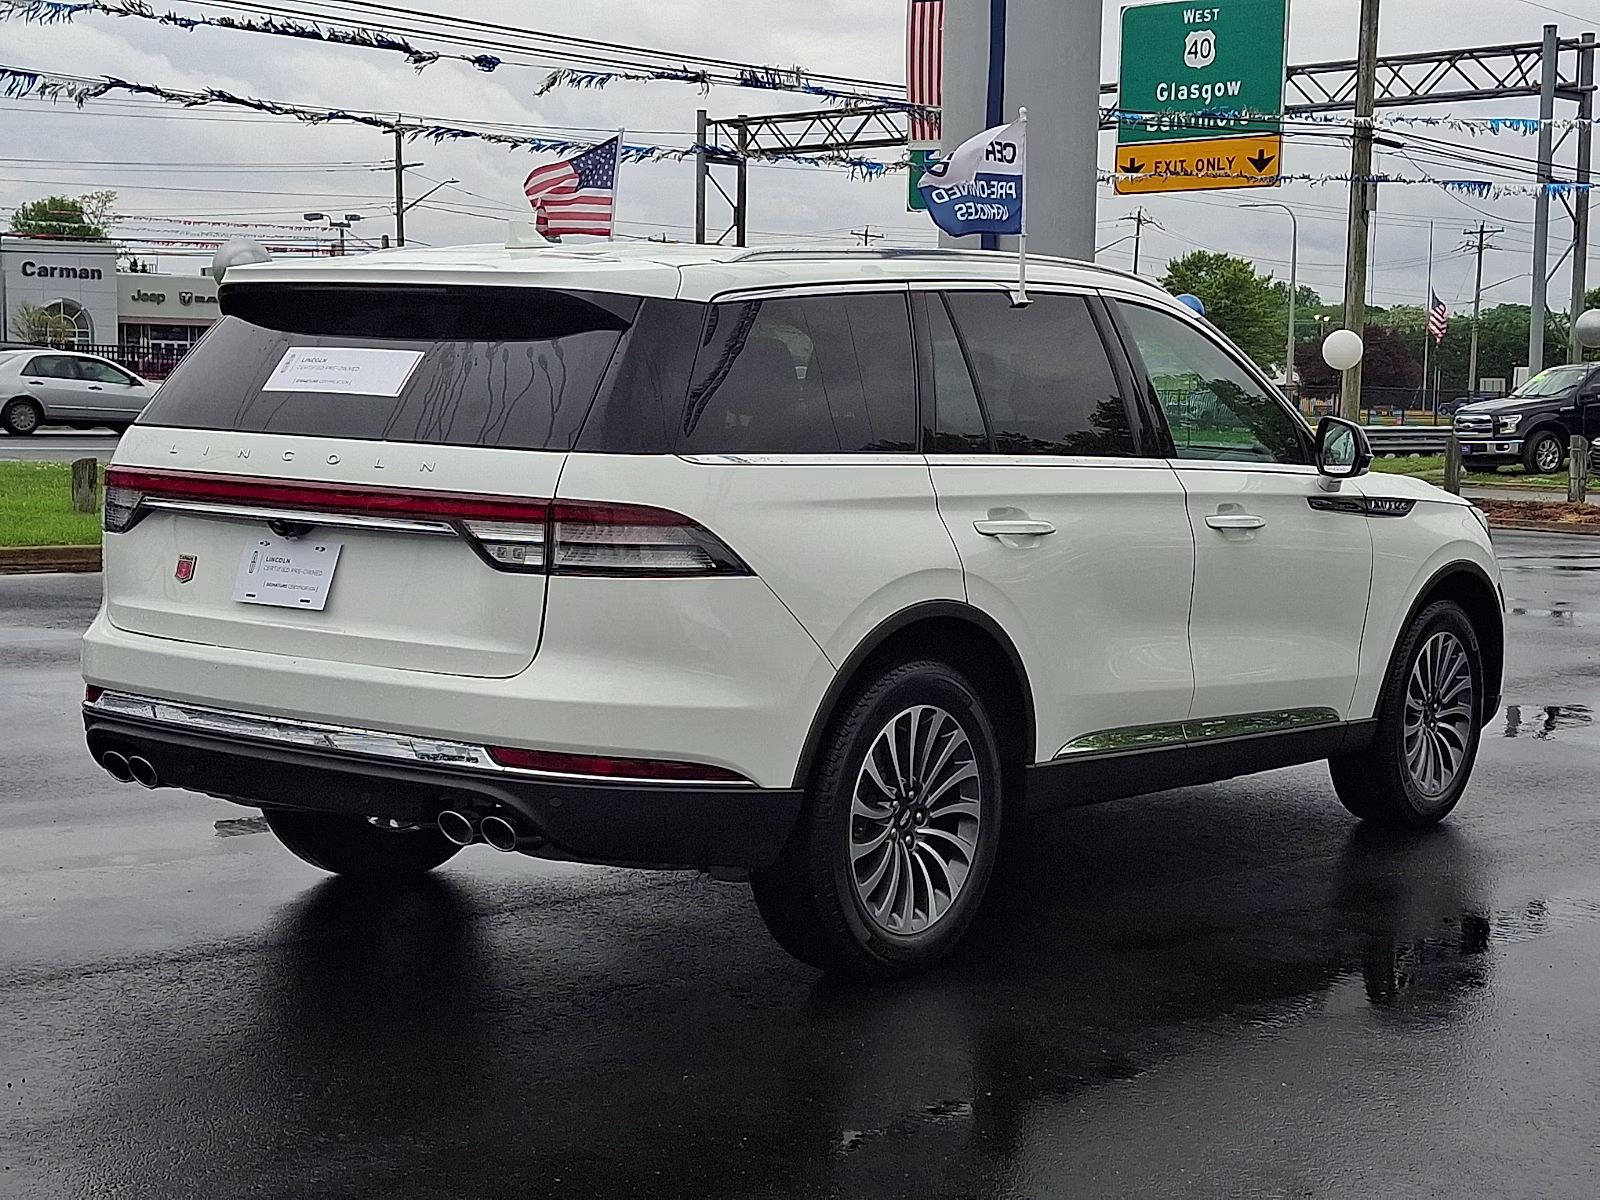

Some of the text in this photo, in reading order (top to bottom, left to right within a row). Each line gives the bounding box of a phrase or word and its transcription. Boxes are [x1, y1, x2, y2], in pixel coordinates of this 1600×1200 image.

[1183, 8, 1220, 24] WEST
[1187, 38, 1212, 60] 40
[1156, 81, 1242, 105] Glasgow
[1154, 155, 1237, 174] EXIT ONLY
[21, 260, 103, 280] Carman
[131, 289, 218, 305] Jeep RA
[169, 444, 436, 473] LINCOLN
